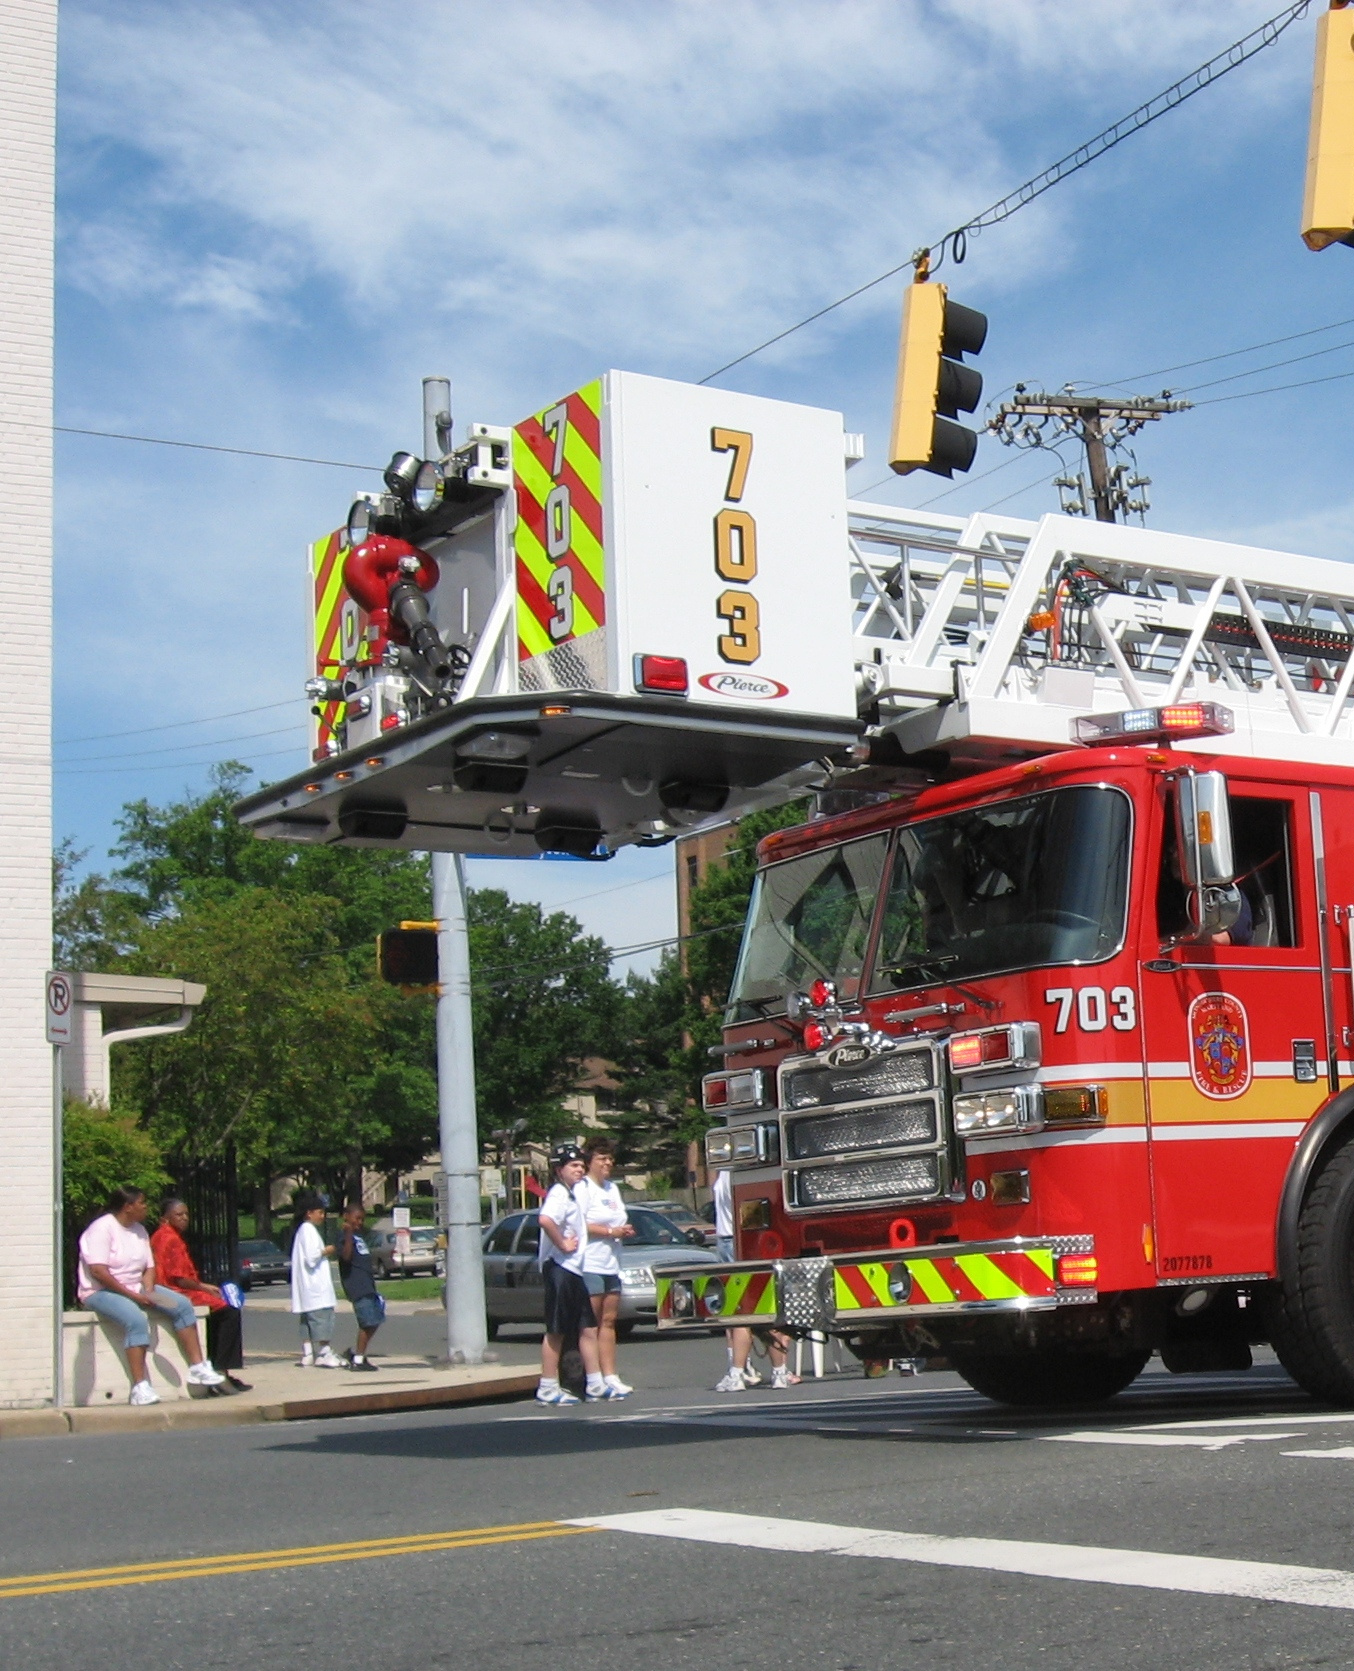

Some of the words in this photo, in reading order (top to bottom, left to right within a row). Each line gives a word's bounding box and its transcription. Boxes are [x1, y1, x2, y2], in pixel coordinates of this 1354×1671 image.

[543, 402, 574, 640] 703
[711, 426, 761, 666] 703
[717, 675, 769, 694] Pierce
[1044, 986, 1136, 1034] 703
